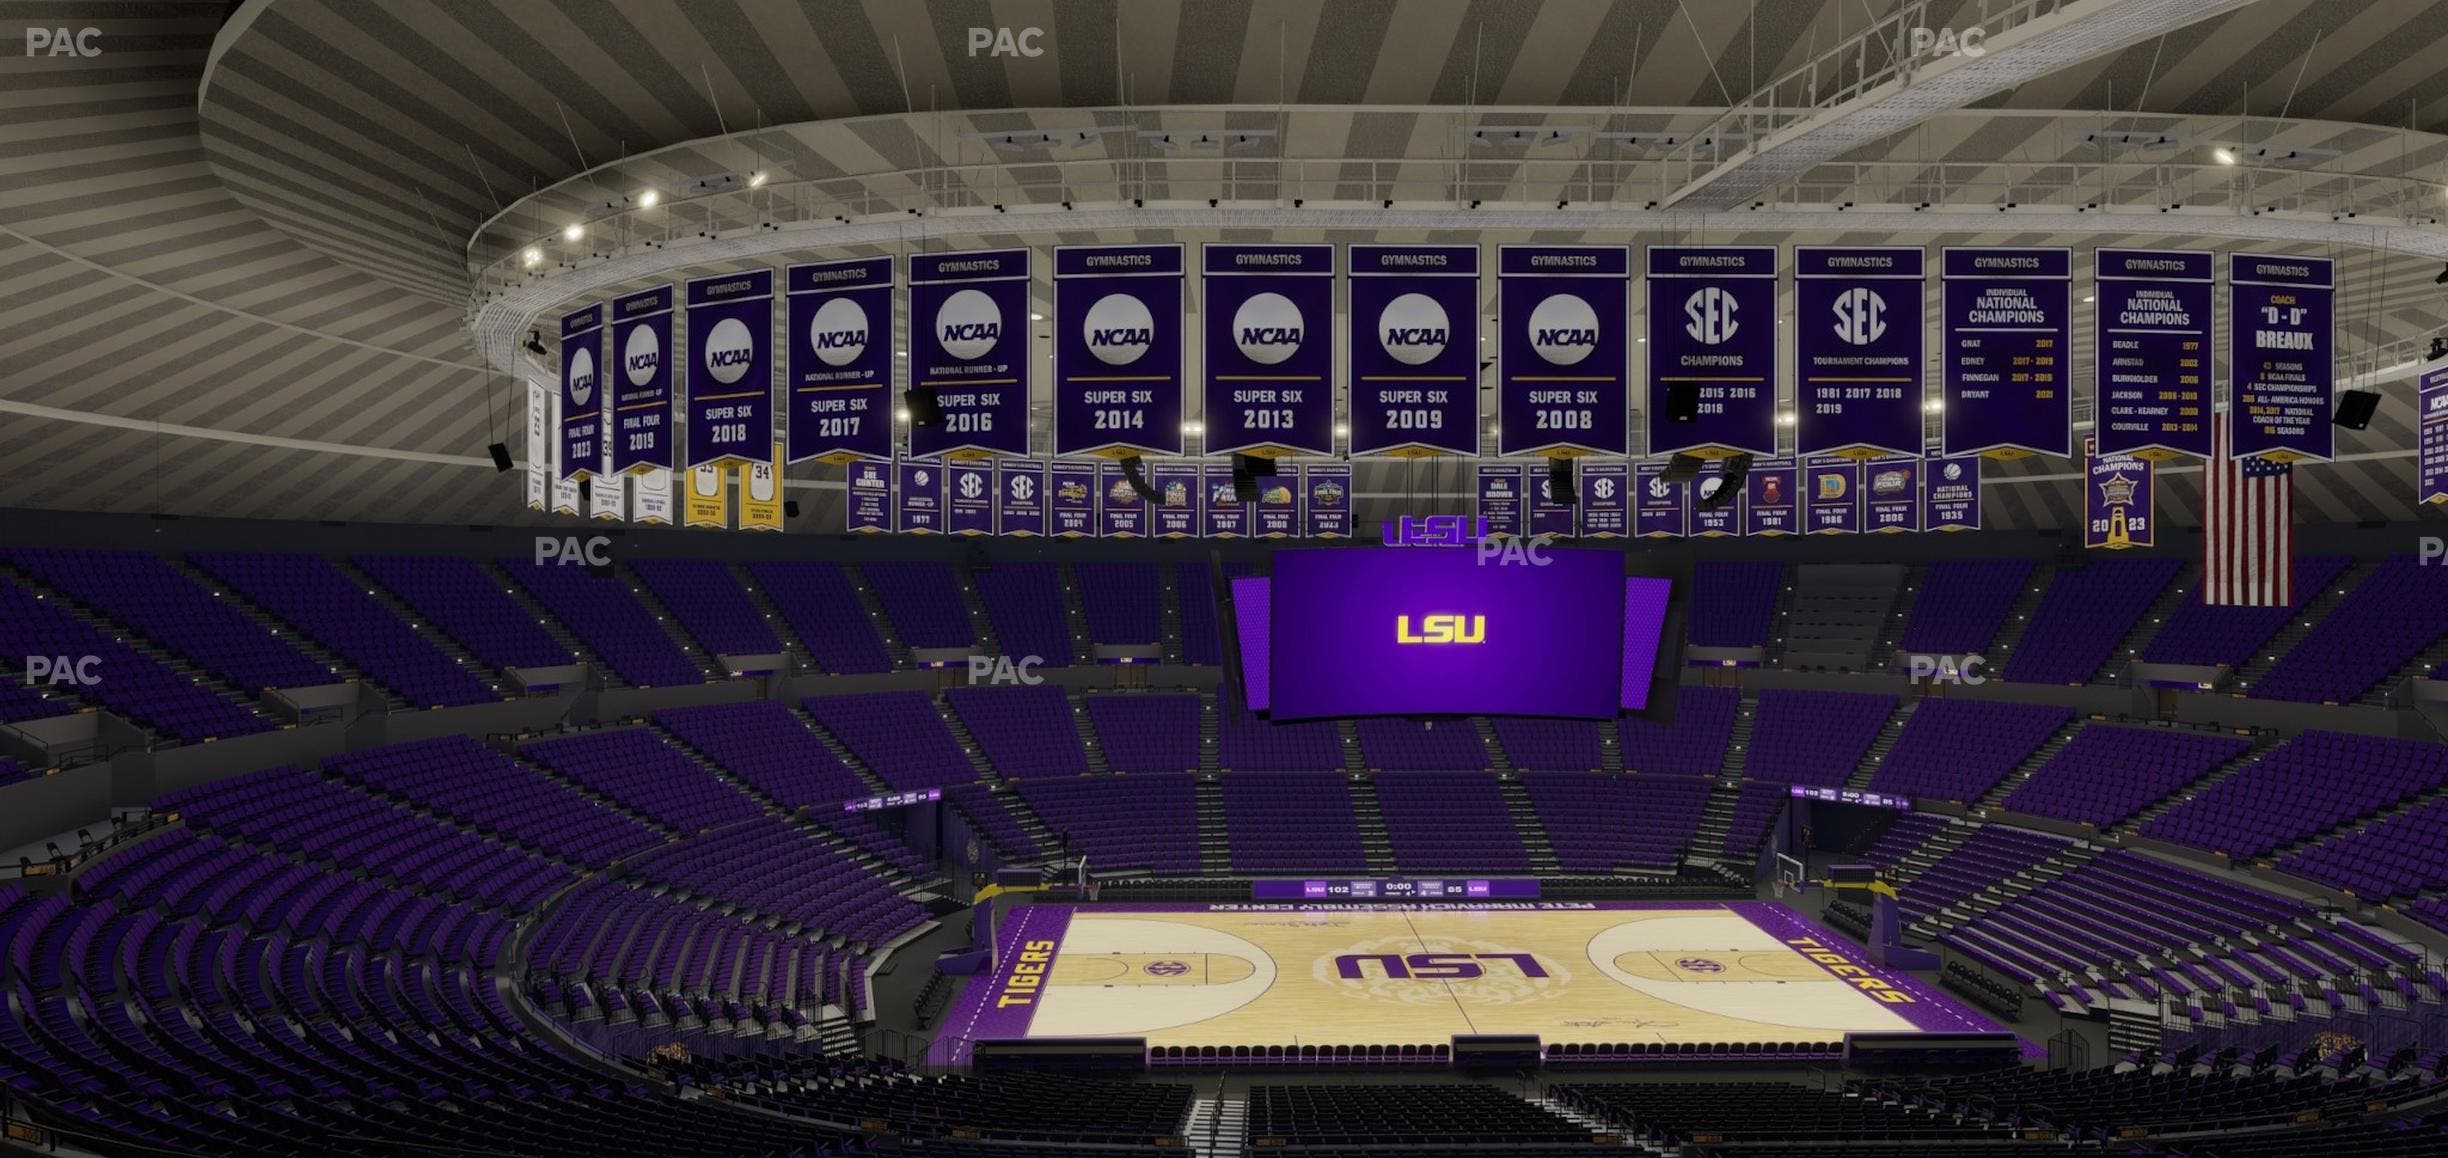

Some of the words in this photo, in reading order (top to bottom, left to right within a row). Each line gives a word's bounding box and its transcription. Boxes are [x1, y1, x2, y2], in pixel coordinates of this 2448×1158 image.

[938, 260, 1000, 272] GYMNASTICS
[1086, 255, 1151, 266] GYMNASTICS
[1236, 254, 1302, 265] GYMNASTICS
[1381, 255, 1447, 266] GYMNASTICS
[1531, 255, 1597, 266] GYMNASTICS
[1680, 256, 1745, 267] GYMNASTICS
[1827, 257, 1893, 268] GYMNASTICS
[1974, 258, 2039, 268] GYMNASTICS
[2125, 259, 2186, 271] GYMNASTICS
[812, 268, 867, 282] GYMNASTICS
[2256, 264, 2310, 277] GYMNASTICS
[707, 281, 751, 295] GYMNASTICS
[1986, 288, 2028, 297] INDIVIDUAL
[2136, 290, 2174, 299] INDIVIDUAL
[1977, 297, 2037, 309] NATIONAL
[2127, 299, 2183, 312] NATIONAL
[2271, 295, 2296, 304] COACH
[1684, 286, 1739, 345] SEC
[1832, 287, 1887, 345] SEC
[1968, 311, 2045, 323] CHAMPIONS
[2120, 312, 2190, 325] CHAMPIONS
[943, 323, 998, 342] NCAA
[1092, 328, 1150, 346] NCAA
[1241, 327, 1301, 345] NCAA
[1387, 328, 1446, 345] NCAA
[1537, 329, 1596, 346] NCAA
[817, 330, 866, 349] NCAA
[2256, 330, 2314, 350] BREAUX
[629, 352, 657, 372] NCAA
[711, 349, 751, 368] NCAA
[1681, 355, 1743, 366] CHAMPIONS
[1813, 357, 1863, 366] TOURNAMENT
[1864, 357, 1909, 366] CHAMPIONS
[930, 366, 963, 375] NATIONAL
[572, 374, 592, 392] NCAA
[1084, 391, 1126, 403] SUPER
[1132, 391, 1152, 403] SIX
[1234, 391, 1276, 403] SUPER
[1282, 391, 1303, 403] SIX
[1379, 391, 1421, 403] SUPER
[1427, 391, 1448, 403] SIX
[1529, 391, 1571, 403] SUPER
[1577, 391, 1598, 403] SIX
[1699, 387, 1724, 398] 2015
[1730, 388, 1756, 398] 2016
[1816, 388, 1840, 399] 1981
[1846, 388, 1870, 399] 2017
[1876, 388, 1901, 399] 2018
[2111, 391, 2142, 399] JACKSON
[811, 400, 845, 412] SUPER
[850, 398, 867, 410] SIX
[937, 395, 975, 407] SUPER
[981, 393, 1000, 406] SIX
[706, 407, 734, 420] SUPER
[737, 406, 752, 417] SIX
[1697, 403, 1723, 414] 2018
[1816, 403, 1842, 414] 2019
[624, 418, 641, 429] FINAL
[643, 414, 660, 426] FOUR
[946, 413, 992, 432] 2016
[1095, 410, 1144, 429] 2014
[1244, 410, 1294, 428] 2013
[1386, 410, 1442, 429] 2009
[1536, 410, 1592, 429] 2008
[712, 424, 746, 442] 2018
[820, 418, 860, 436] 2017
[630, 432, 654, 451] 2019
[2103, 455, 2134, 464] NATIONAL
[755, 465, 770, 479] 34
[2092, 462, 2145, 475] CHAMPIONS
[960, 472, 983, 498] SEC
[1011, 475, 1034, 500] SEC
[1594, 478, 1615, 499] SEC
[1933, 491, 1973, 500] CHAMPIONS
[1941, 511, 1963, 520] 1935
[1704, 519, 1724, 527] 1953
[2092, 519, 2109, 532] 20
[2128, 517, 2146, 531] 23
[1397, 615, 1486, 644] LSU
[1209, 903, 1294, 912] CENTER
[1299, 903, 1417, 912] ASSEMBLY
[1421, 903, 1537, 911] MARAVICH
[1540, 903, 1597, 911] PETE
[1335, 953, 1550, 979] LSU
[1787, 936, 1917, 1005] TIGERS
[997, 940, 1054, 1008] TIGERS
